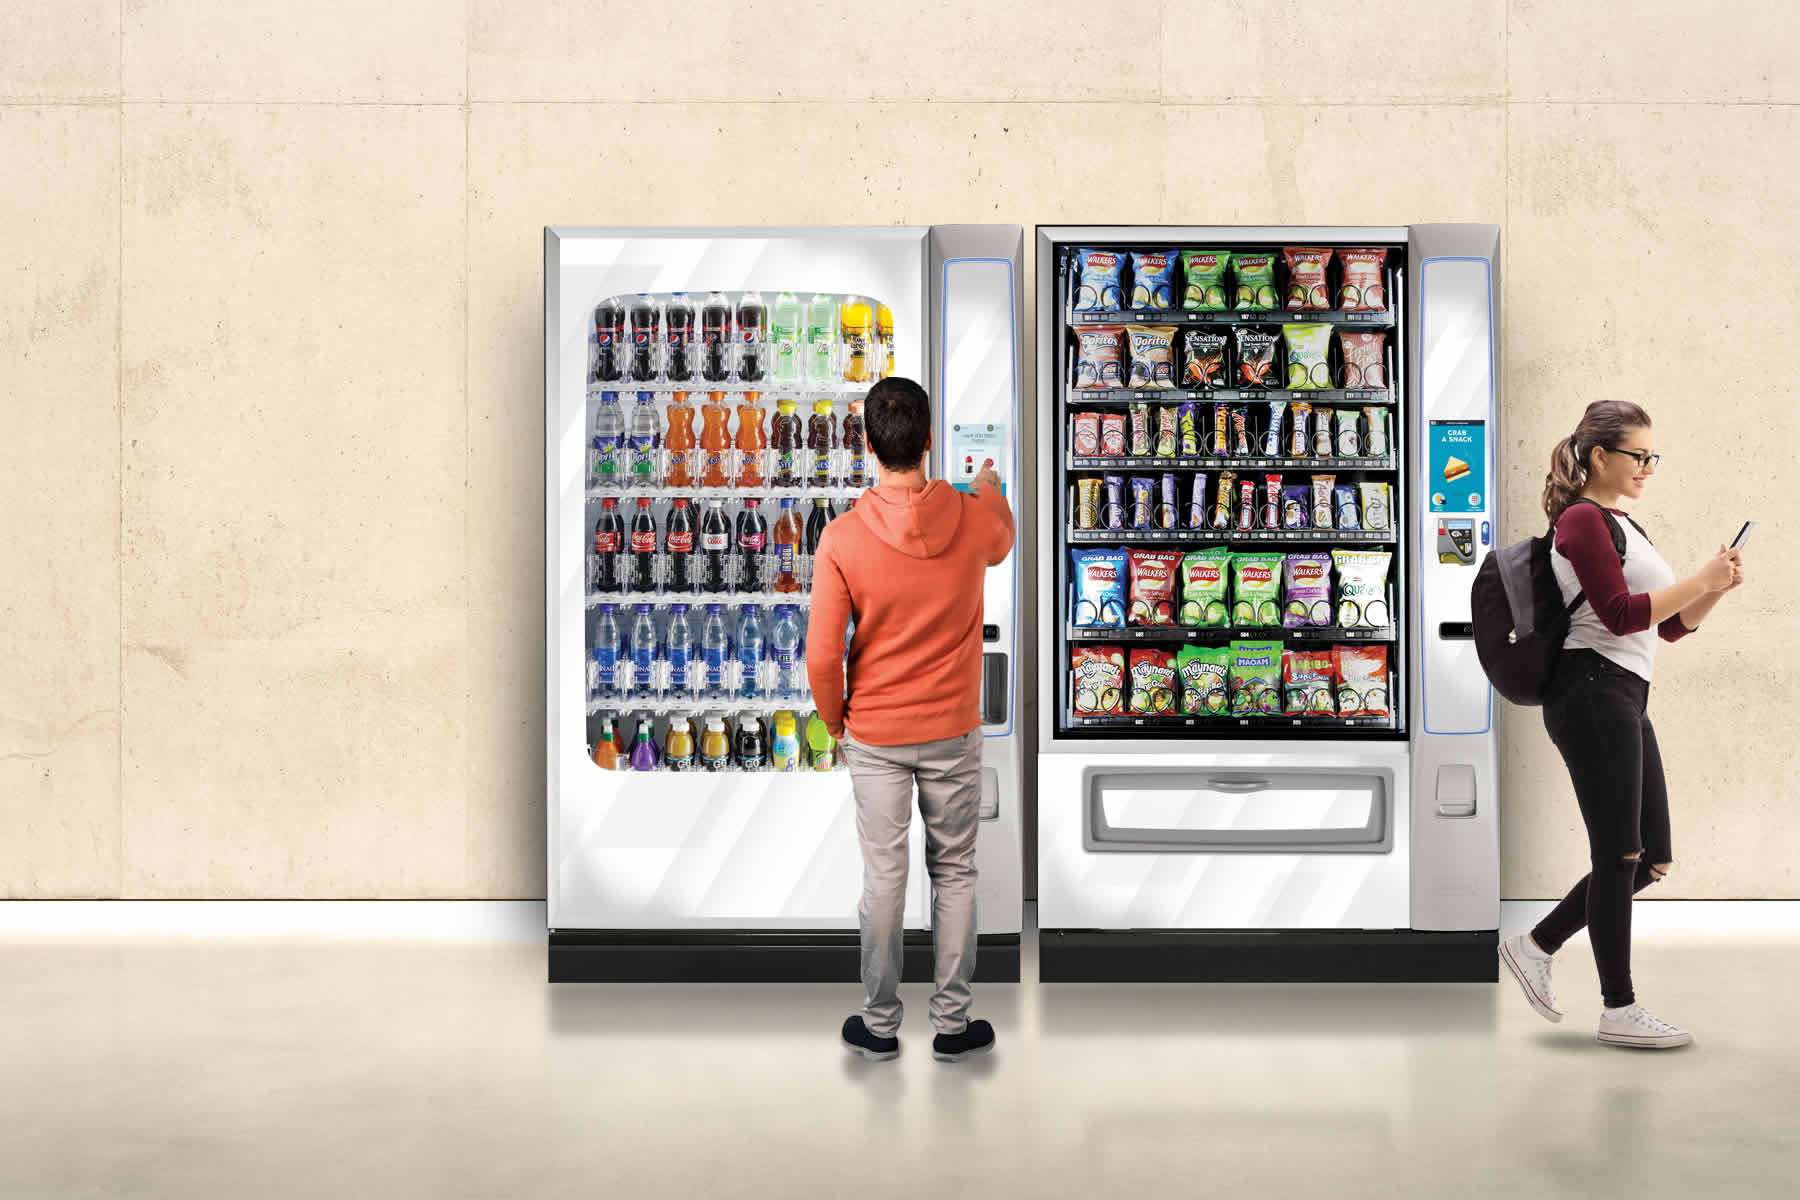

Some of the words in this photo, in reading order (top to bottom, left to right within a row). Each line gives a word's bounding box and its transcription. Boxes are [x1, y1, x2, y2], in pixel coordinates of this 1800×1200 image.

[1088, 254, 1117, 264] WALKERS
[1139, 255, 1167, 265] WALKERS
[1190, 255, 1217, 264] WALKERS
[1239, 257, 1267, 266] WALKERS
[1294, 254, 1323, 262] WALKERS
[1346, 253, 1377, 261] WALKERS
[1082, 335, 1118, 346] Doritos
[1088, 567, 1117, 578] WALKERS
[1137, 567, 1168, 578] WALKERS
[1190, 567, 1220, 578] WALKERS
[1240, 569, 1272, 579] WALKERS
[1294, 566, 1325, 577] WALKERS
[1237, 657, 1270, 666] MAOAM
